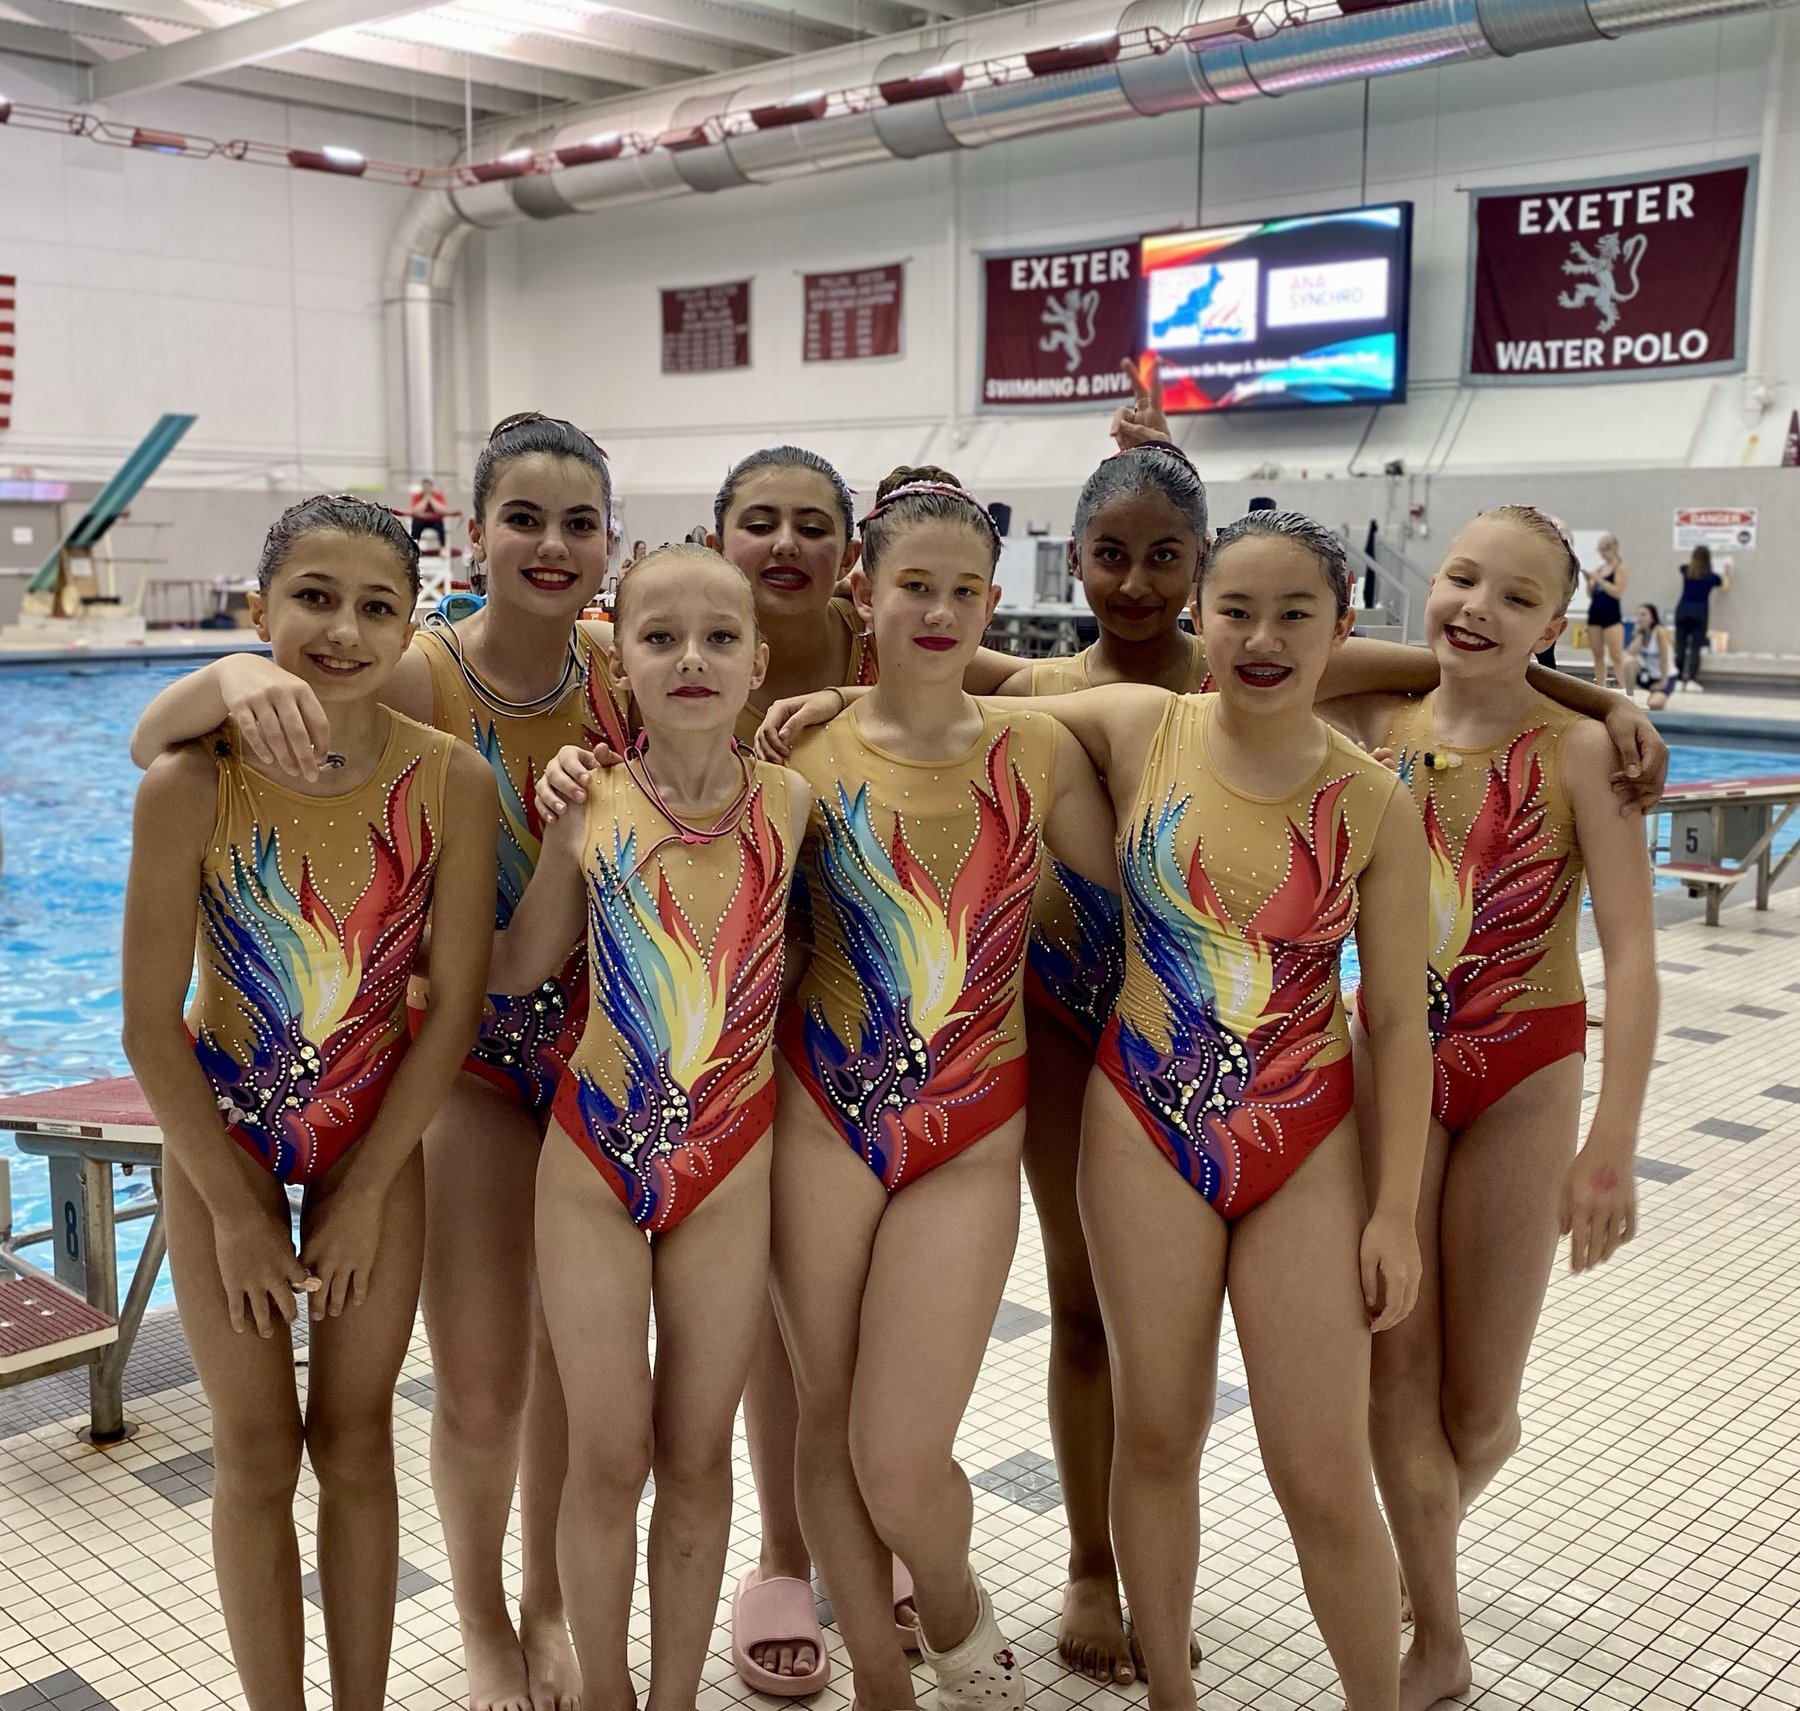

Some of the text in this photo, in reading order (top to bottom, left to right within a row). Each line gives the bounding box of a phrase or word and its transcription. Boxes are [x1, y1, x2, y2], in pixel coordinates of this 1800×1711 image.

[1518, 182, 1695, 235] EXETER
[1011, 249, 1131, 290] EXETER
[1291, 274, 1326, 290] ANA
[1289, 286, 1363, 310] SYNCHRO
[1496, 329, 1708, 370] WATER POLO
[986, 377, 1074, 399] SWIMMING
[1076, 376, 1089, 396] &
[1685, 827, 1698, 853] 5
[64, 1201, 79, 1262] 8
